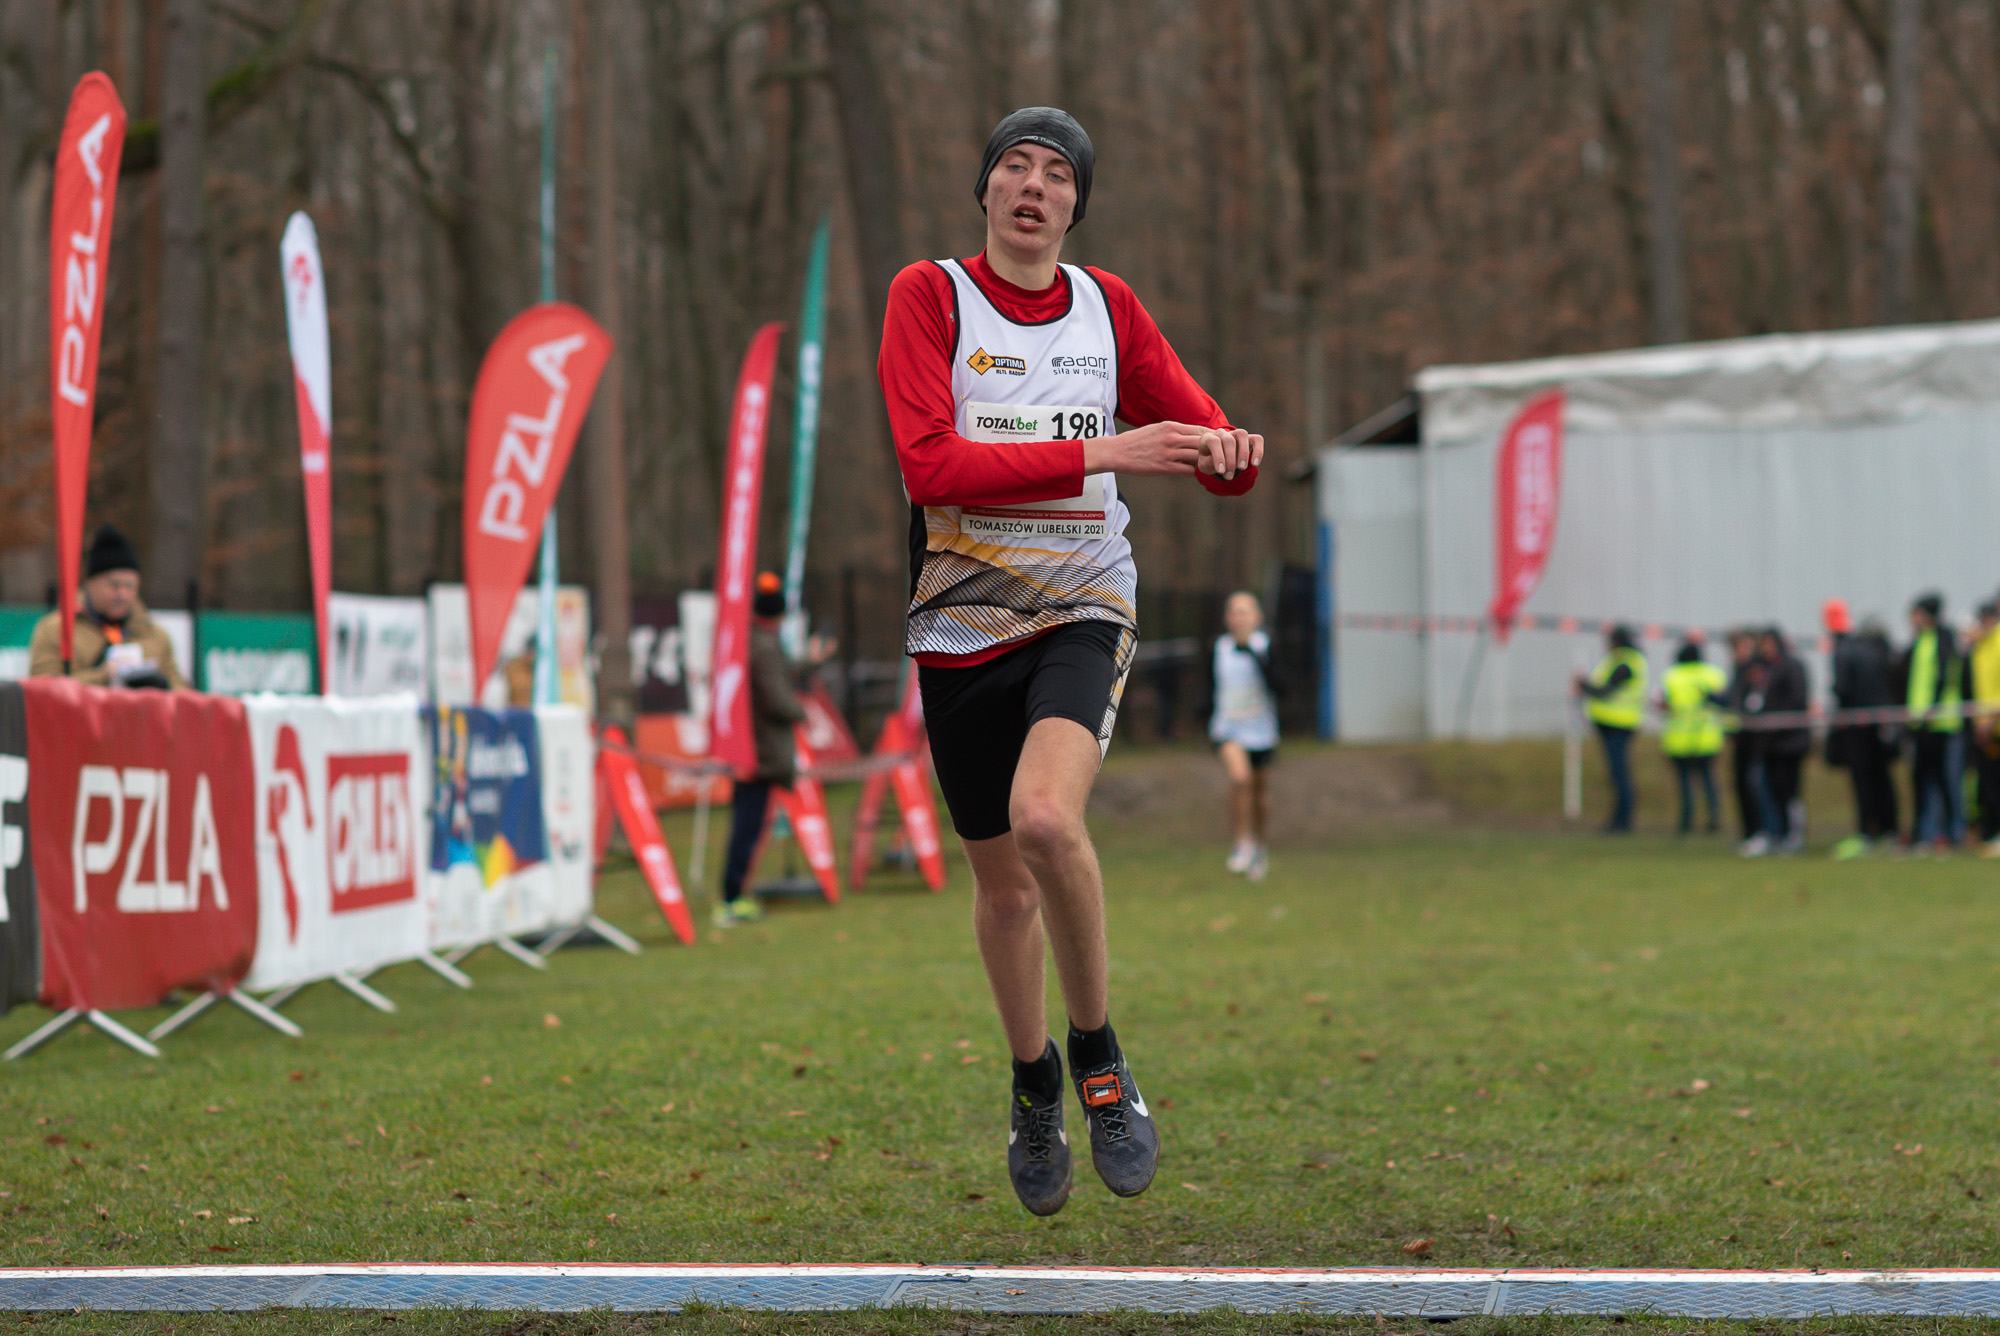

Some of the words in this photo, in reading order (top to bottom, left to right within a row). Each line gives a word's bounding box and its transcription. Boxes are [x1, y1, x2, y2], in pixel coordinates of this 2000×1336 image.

[59, 113, 111, 406] PZLA
[995, 357, 1025, 369] OPTIMA
[480, 333, 587, 541] PZLA
[1051, 412, 1098, 440] 198
[969, 520, 1034, 533] TOMASZÓW
[1037, 524, 1081, 535] LUBELSKI
[1084, 525, 1104, 535] 2021
[72, 764, 229, 913] PZLA
